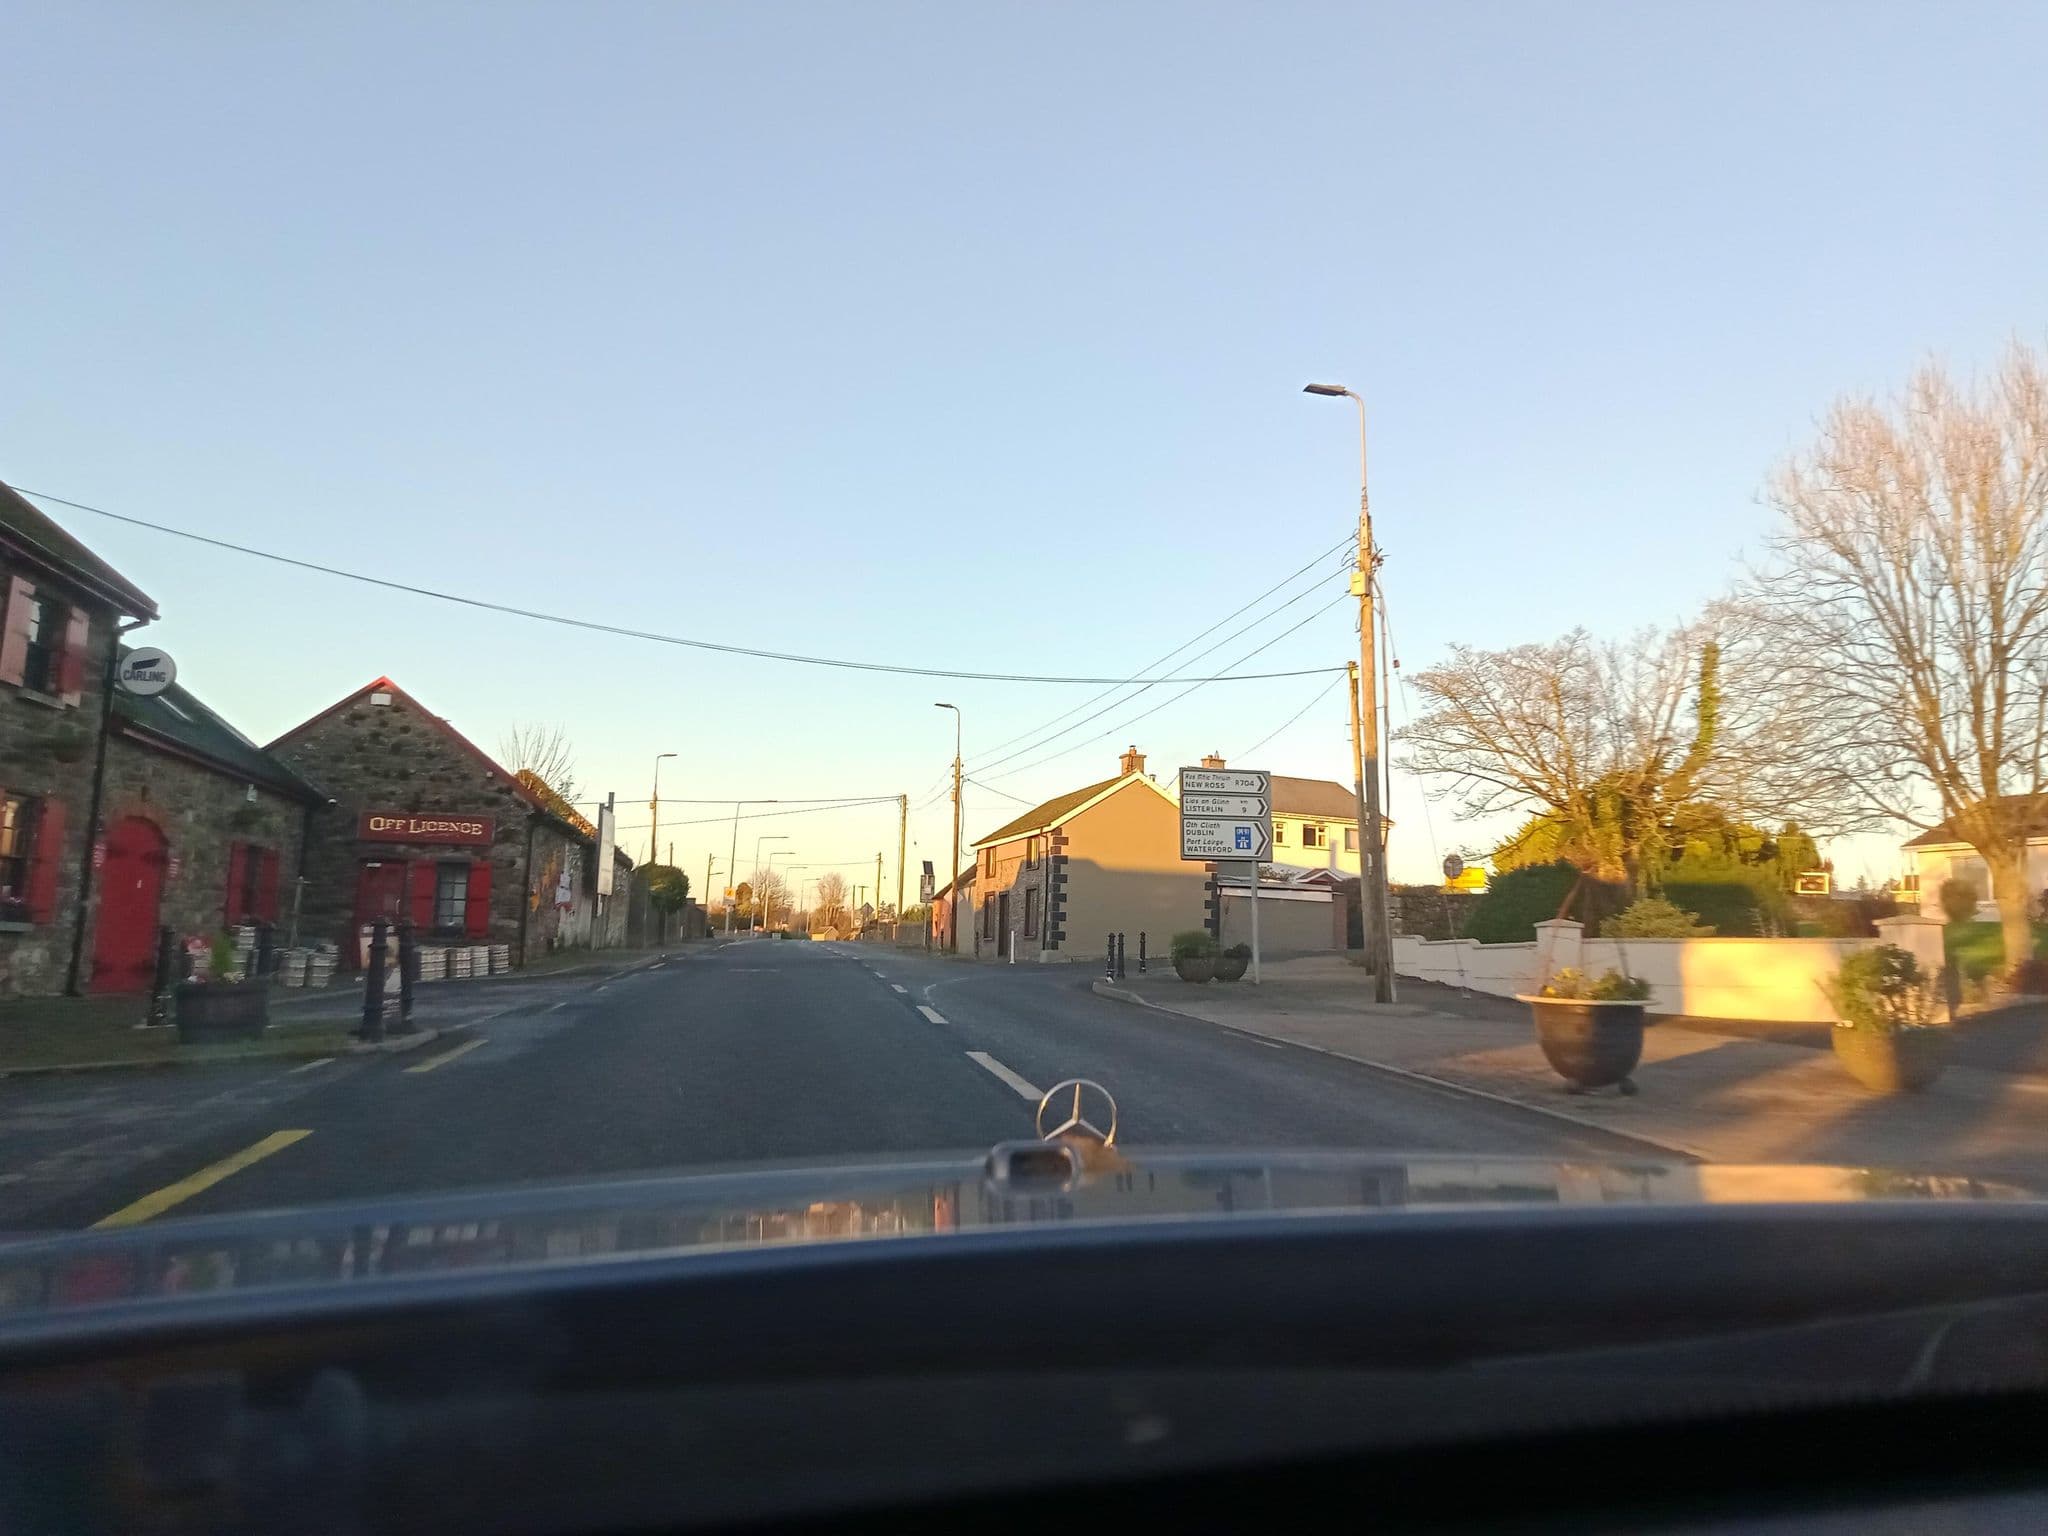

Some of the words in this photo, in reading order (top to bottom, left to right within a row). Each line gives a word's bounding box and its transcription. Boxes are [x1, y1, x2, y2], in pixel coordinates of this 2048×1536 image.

[123, 670, 166, 682] CARLING
[1235, 779, 1254, 787] R704
[1185, 805, 1223, 813] LISTERLIN
[369, 816, 406, 832] OFF
[408, 818, 483, 835] LICENCE
